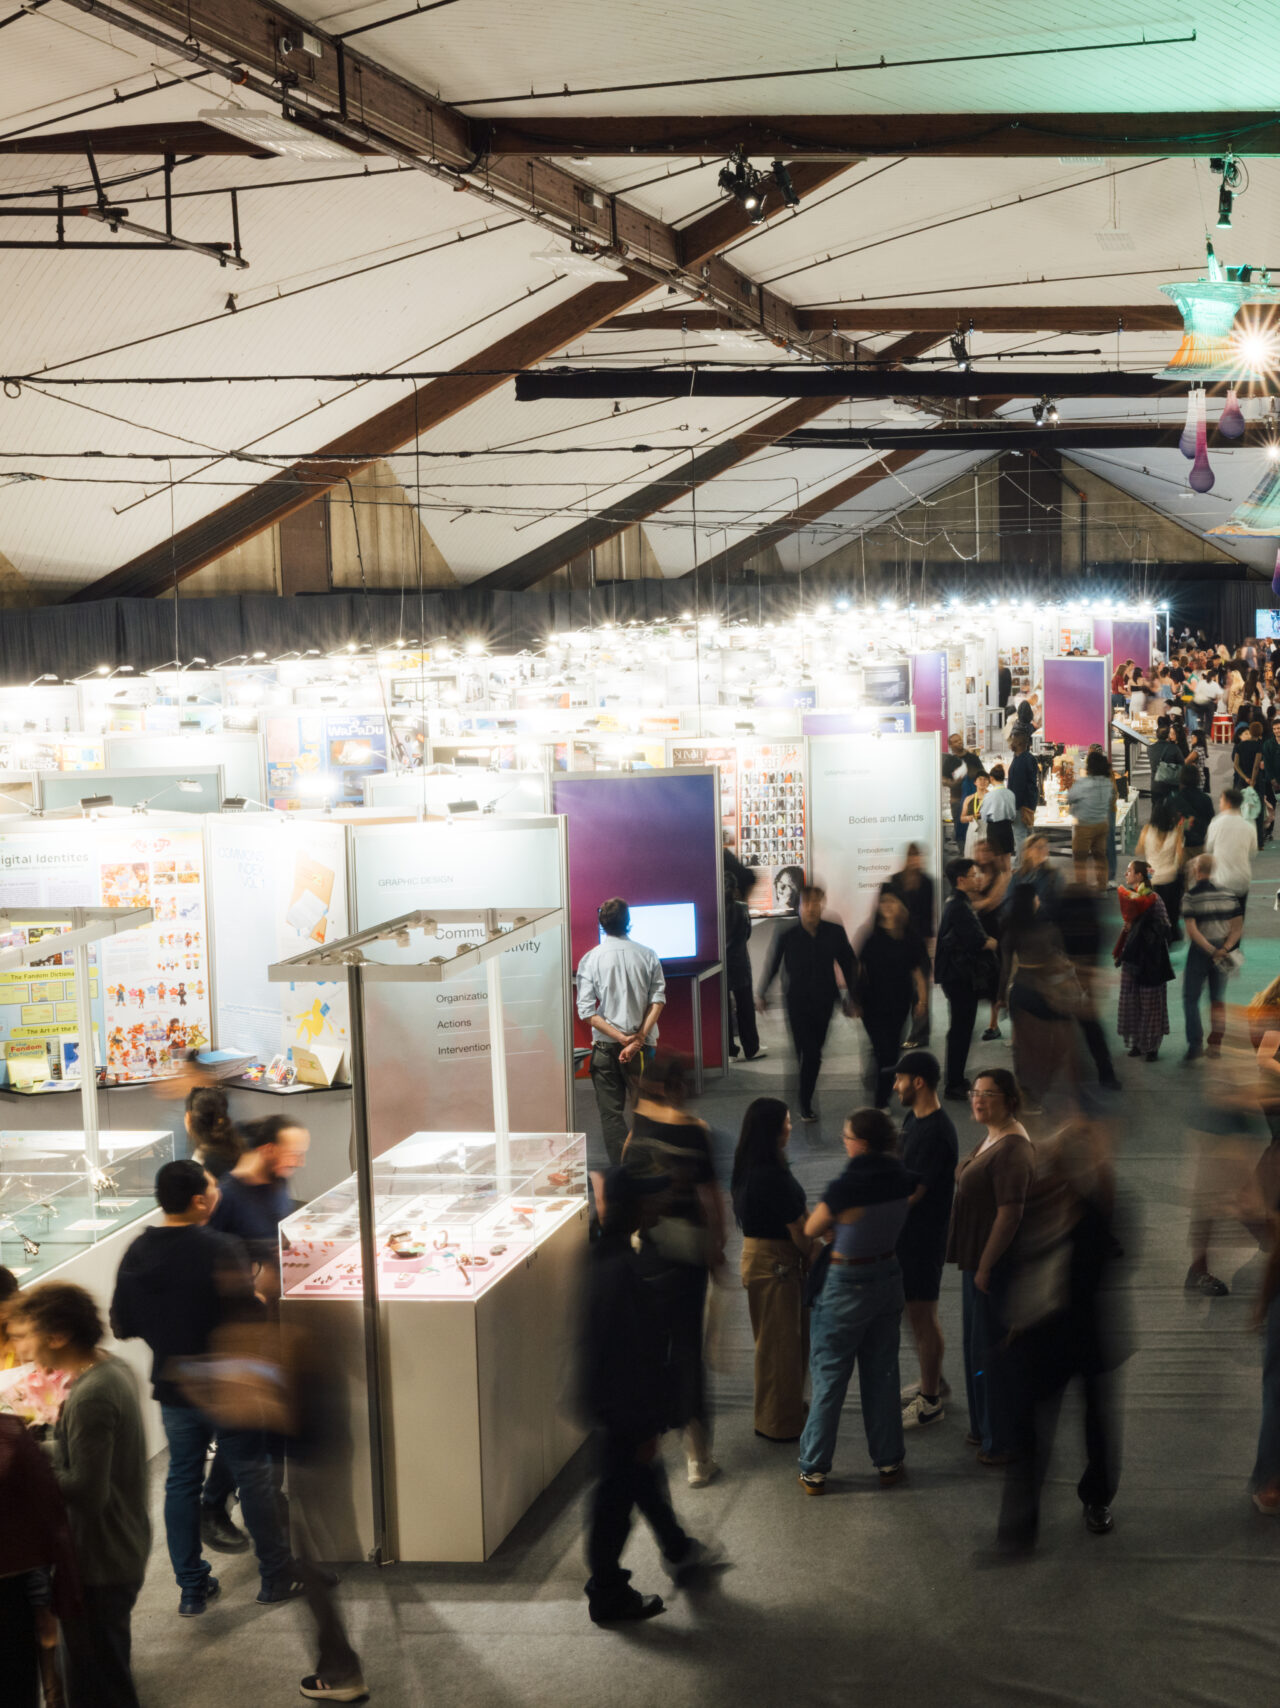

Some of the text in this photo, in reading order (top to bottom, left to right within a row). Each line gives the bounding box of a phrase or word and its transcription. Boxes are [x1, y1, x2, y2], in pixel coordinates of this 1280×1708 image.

[848, 813, 924, 825] Bodies and Minds
[0, 854, 32, 868] igital
[857, 864, 892, 873] Psychology
[378, 874, 454, 888] GRAPHIC DESIGN
[11, 970, 75, 981] The Fandom Dictiona
[436, 991, 488, 1005] Organizatio
[437, 1017, 472, 1030] Actions
[26, 1027, 38, 1035] The
[10, 1044, 42, 1053] Fandom
